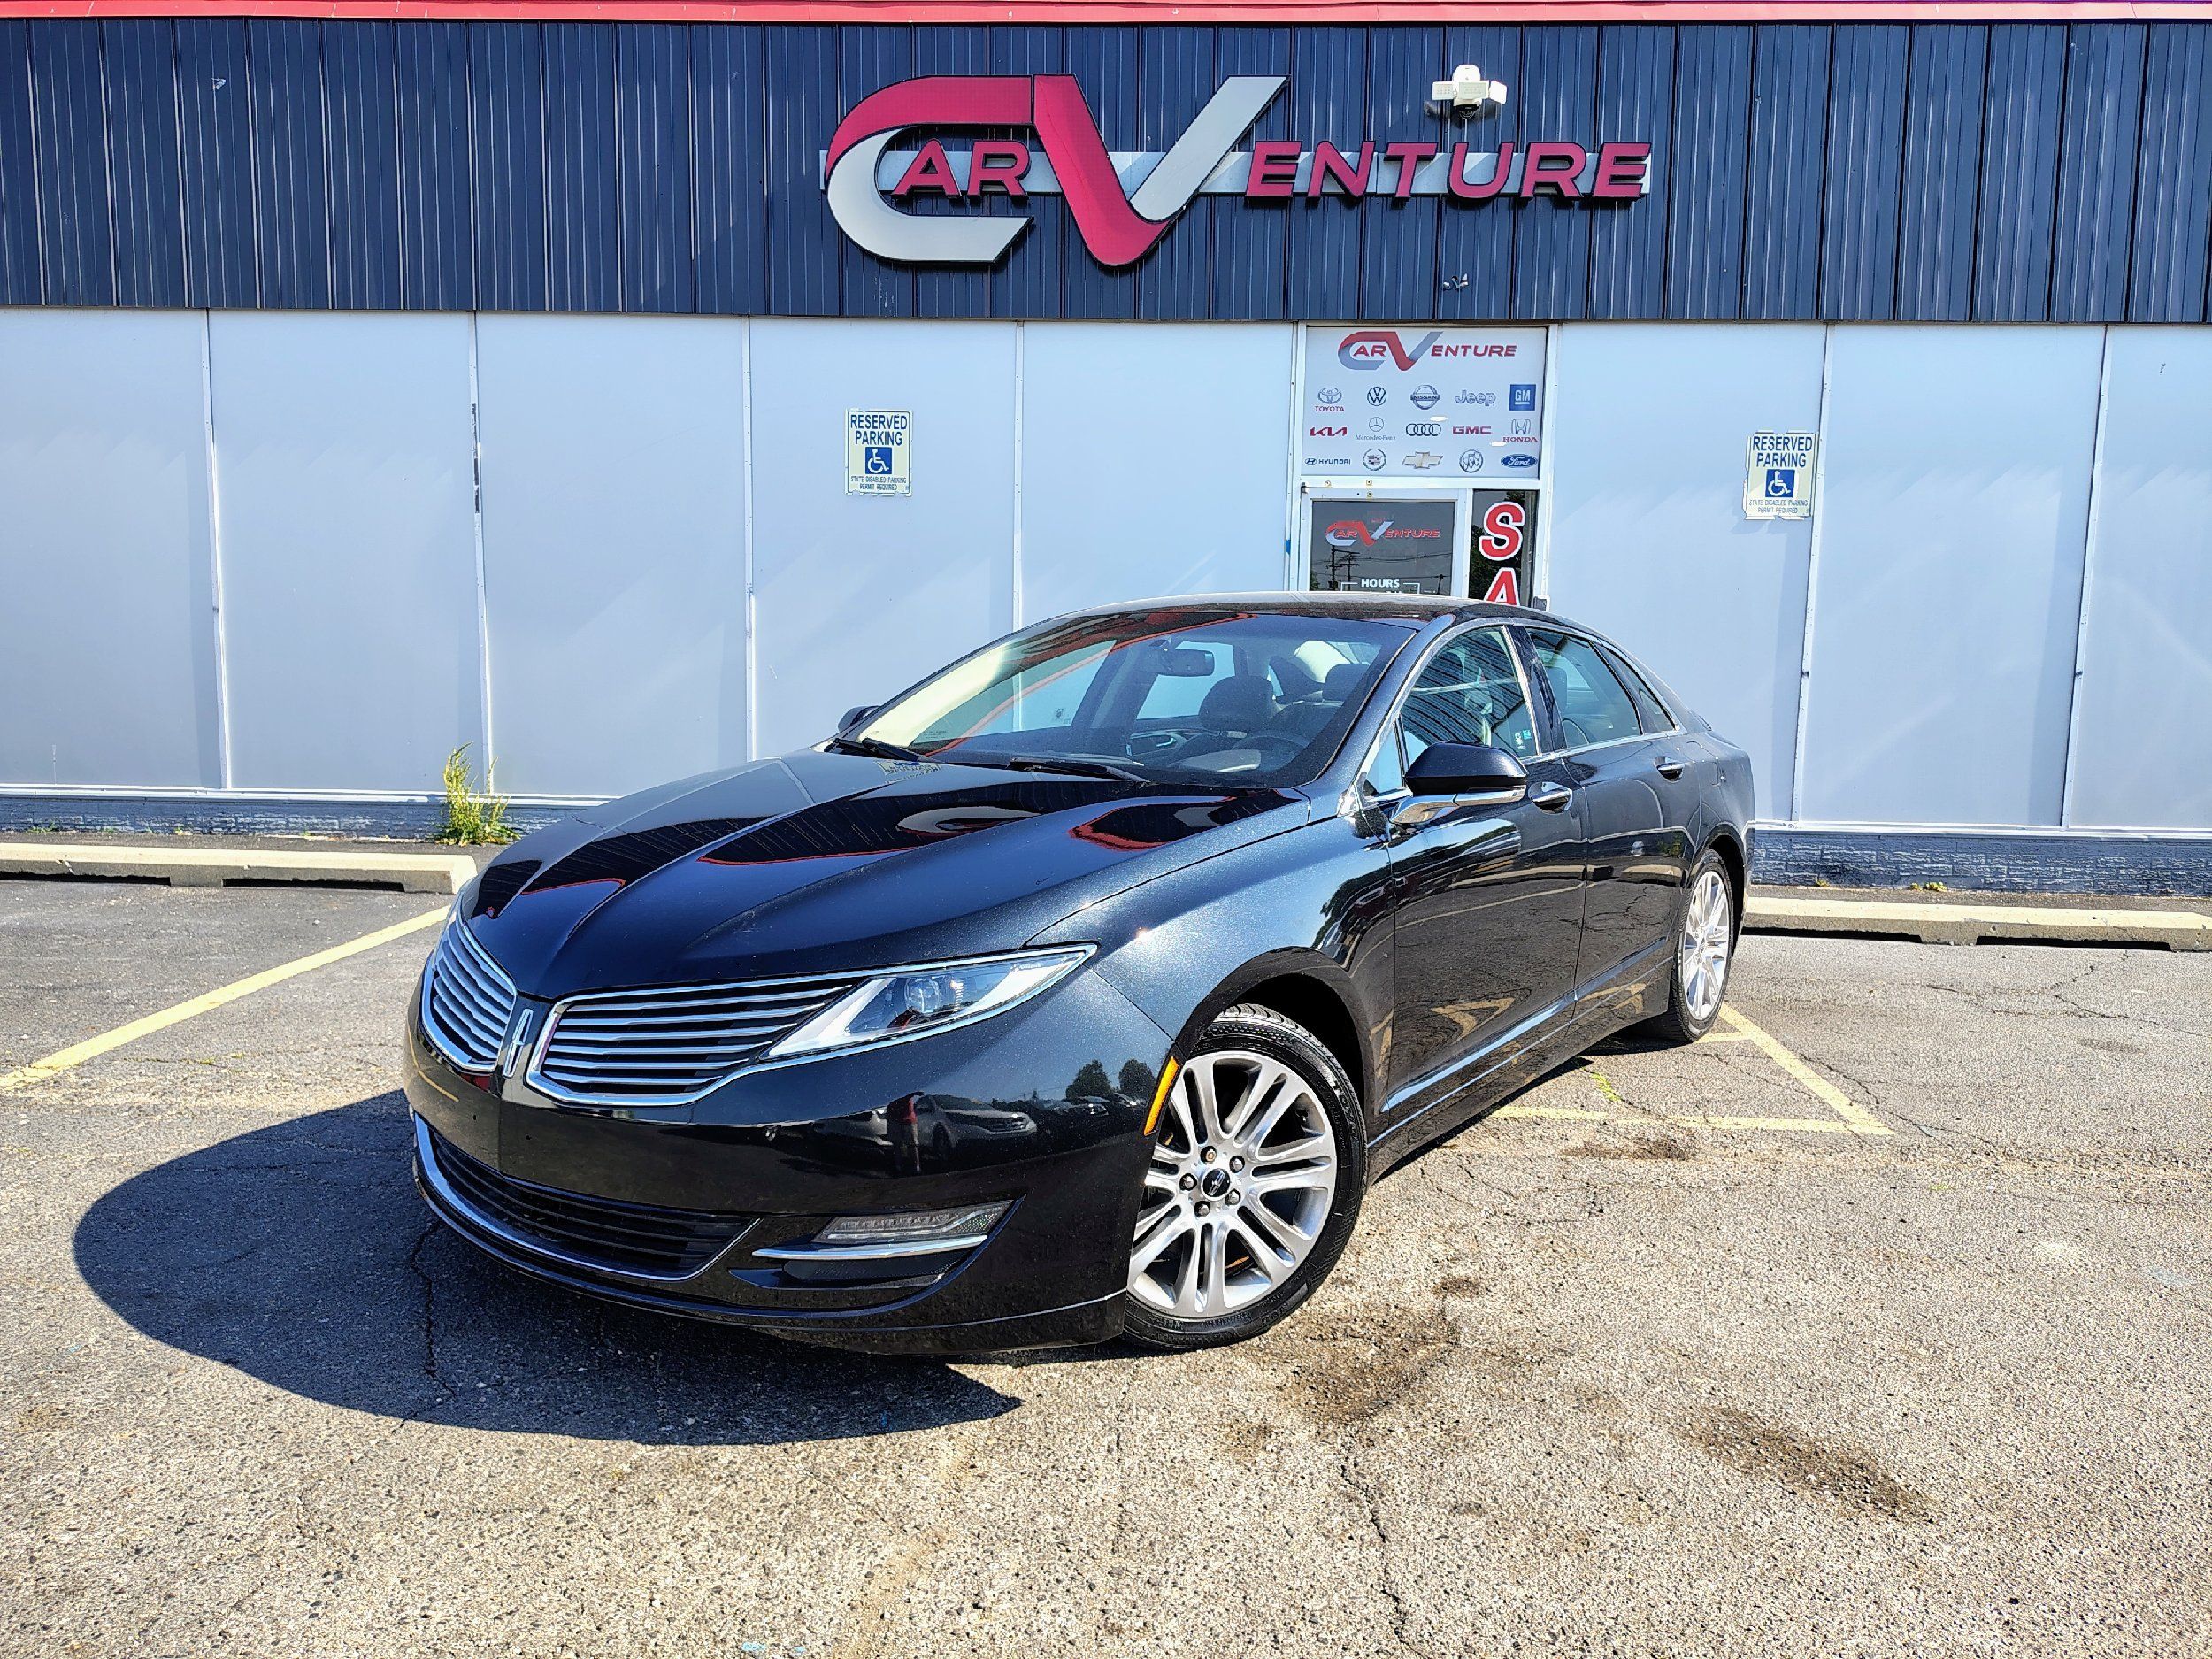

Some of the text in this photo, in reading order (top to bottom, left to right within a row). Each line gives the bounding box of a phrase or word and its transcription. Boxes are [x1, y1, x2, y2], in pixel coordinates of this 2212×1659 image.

[1455, 389, 1496, 406] Jeep
[1515, 389, 1531, 402] GM
[850, 414, 908, 430] RESERVED
[1452, 426, 1492, 434] GMC
[855, 430, 902, 446] PARKING
[1753, 436, 1813, 451] RESERVED
[1756, 452, 1807, 467] PARKING
[1361, 578, 1401, 588] HOURS
